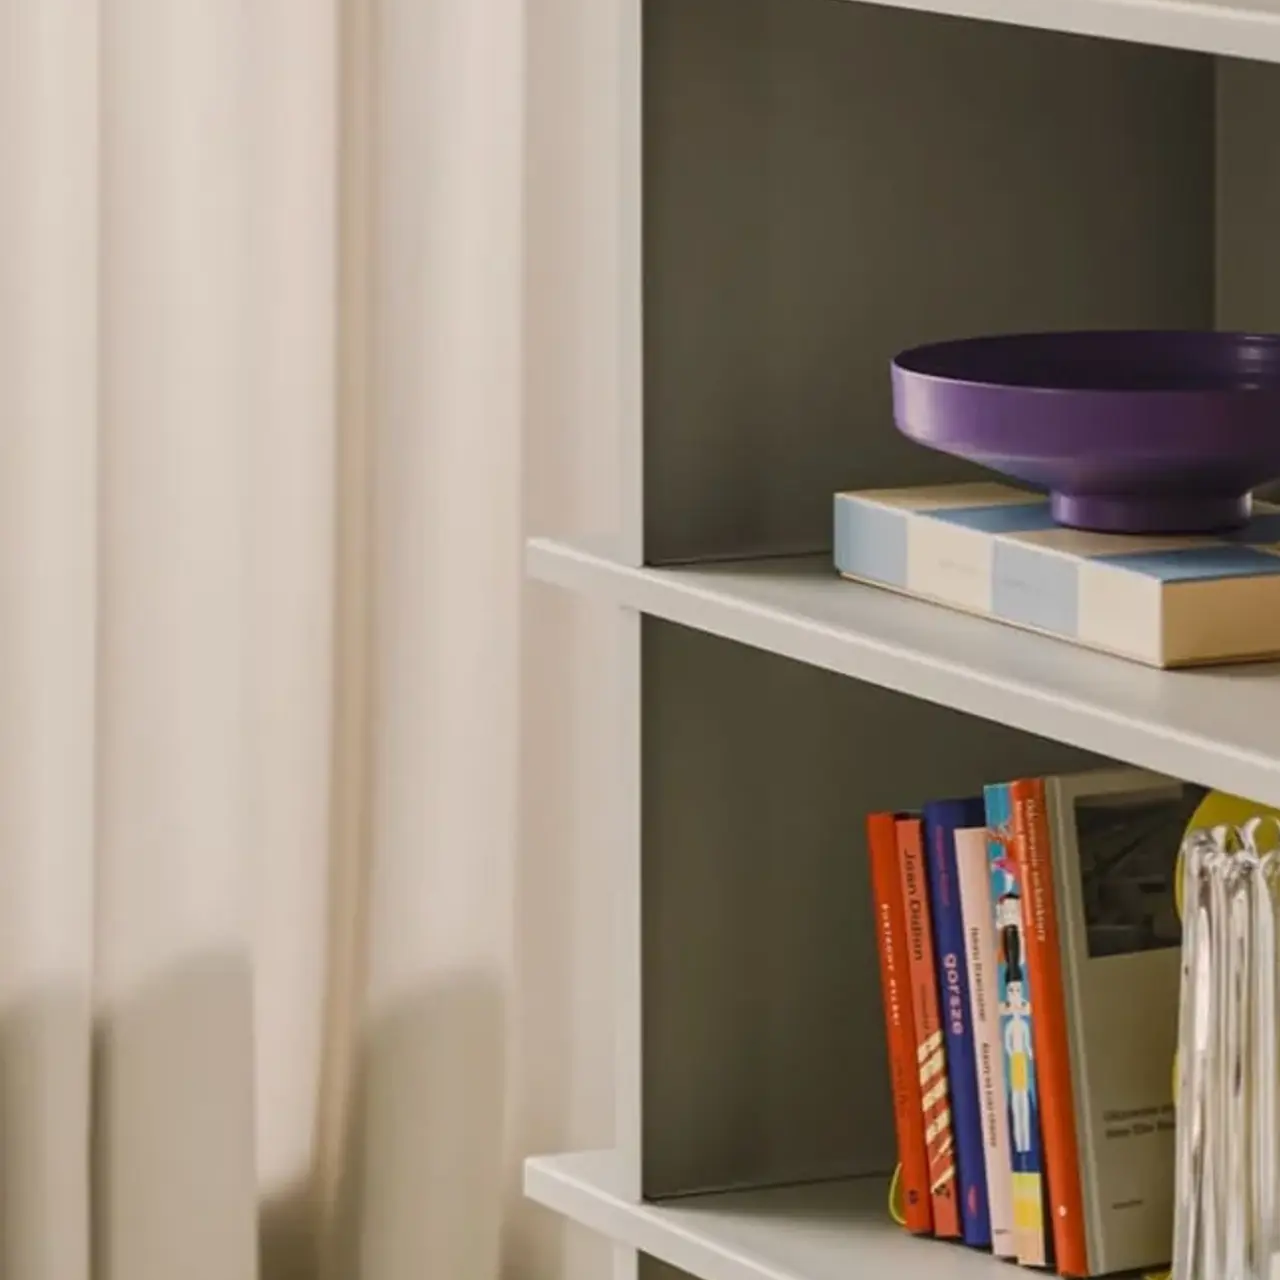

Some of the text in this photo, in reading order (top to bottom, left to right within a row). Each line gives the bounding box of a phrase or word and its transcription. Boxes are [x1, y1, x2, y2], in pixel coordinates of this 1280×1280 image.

[904, 847, 924, 961] Joan Didion
[943, 952, 964, 1035] gorsze
